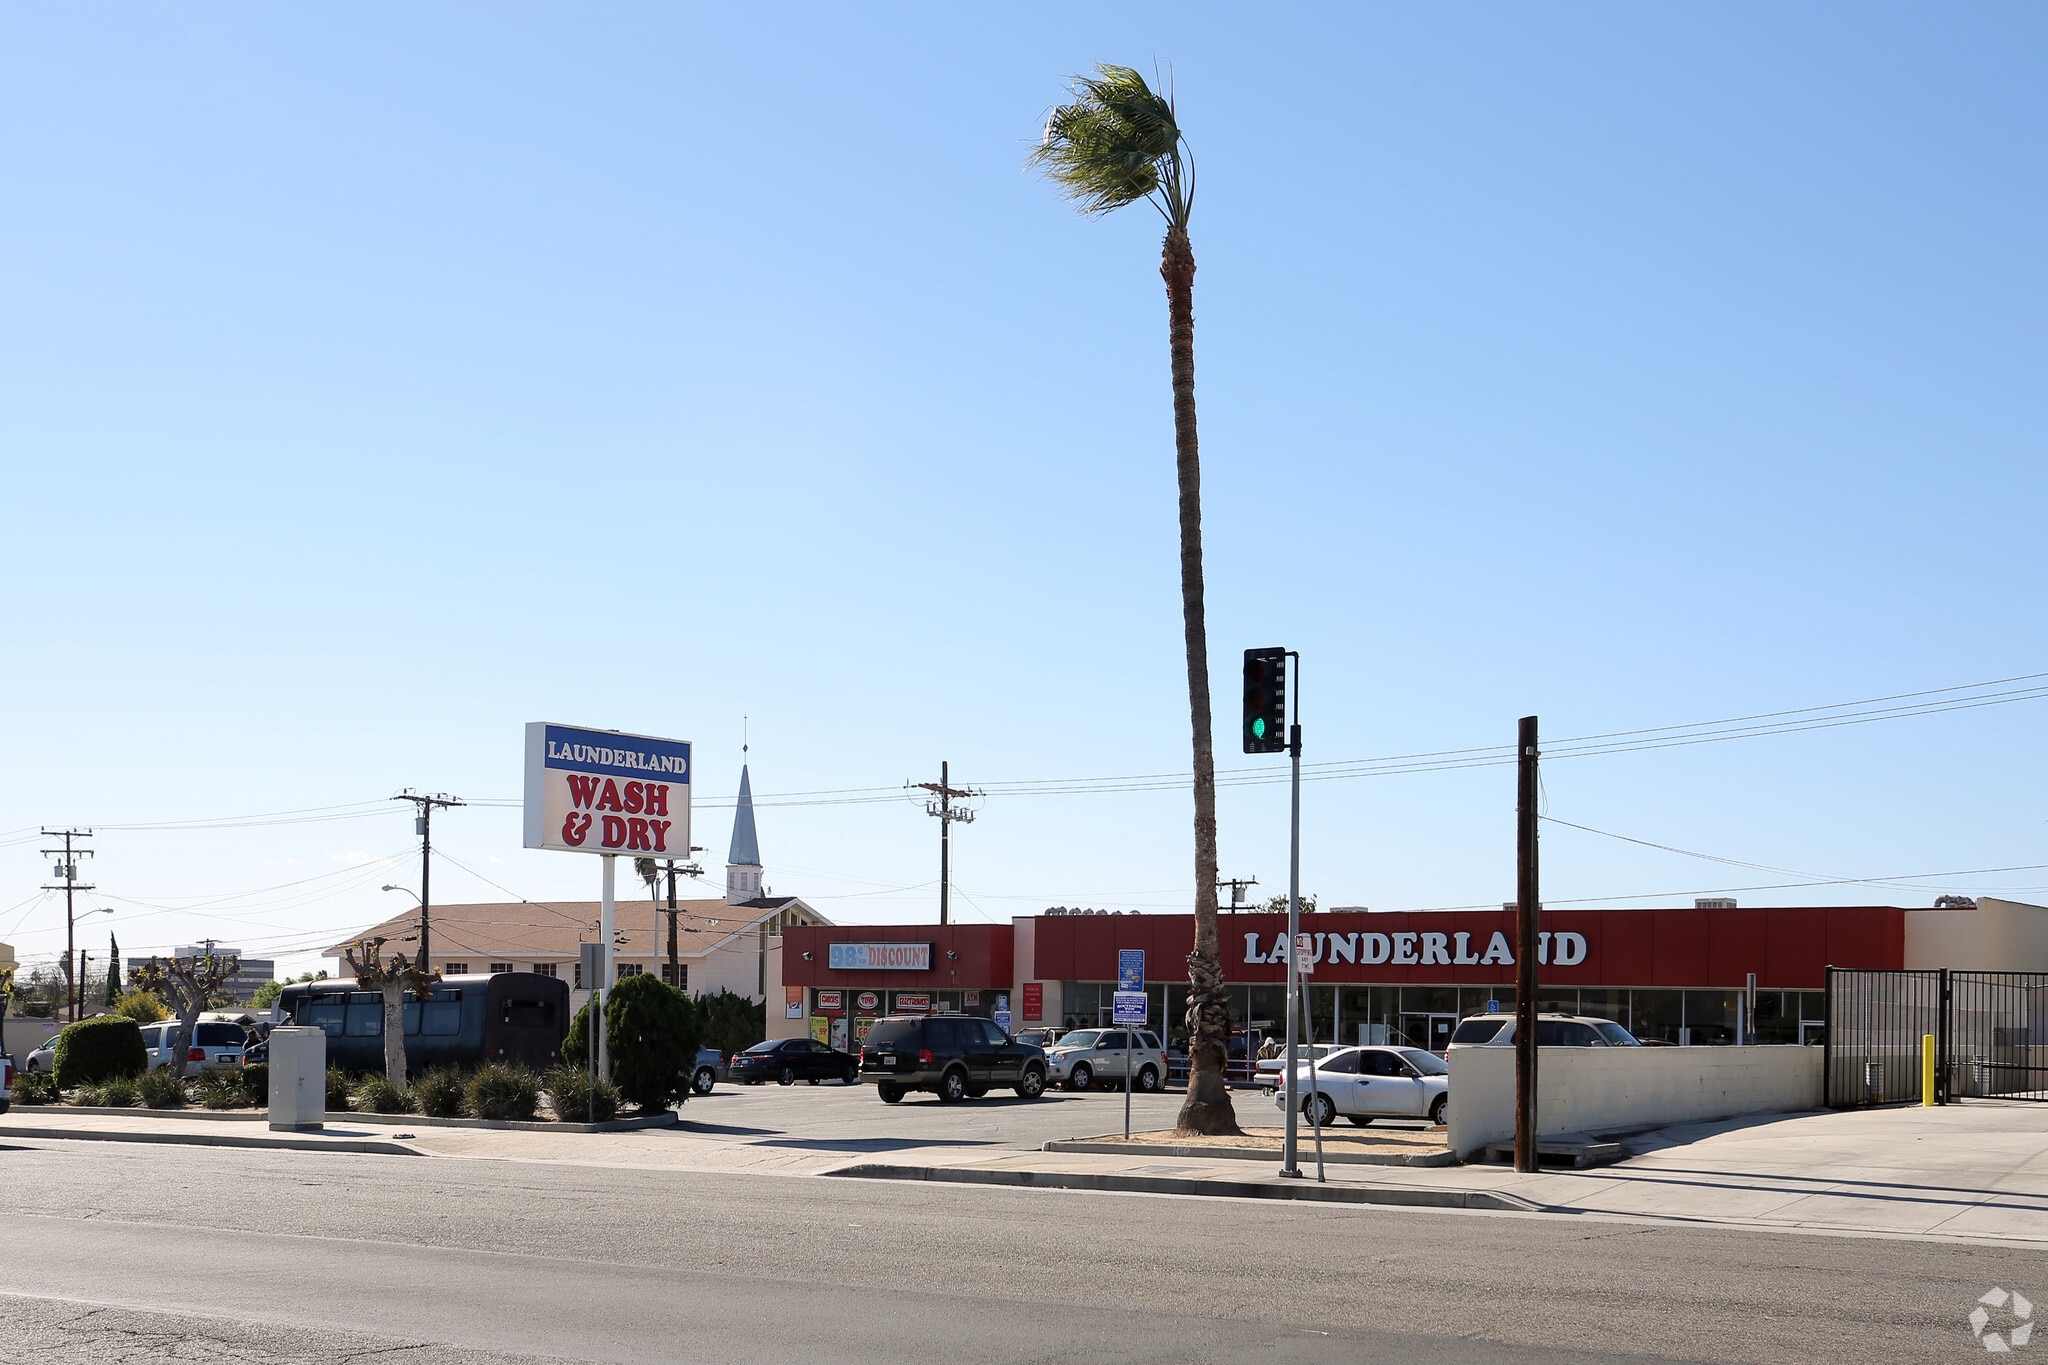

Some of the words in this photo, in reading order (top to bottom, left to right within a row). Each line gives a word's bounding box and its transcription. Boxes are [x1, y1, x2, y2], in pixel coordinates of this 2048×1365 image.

[548, 741, 687, 774] LAUNDERLAND
[566, 774, 670, 817] WASH
[562, 811, 593, 847] &
[600, 815, 672, 852] DRY
[868, 947, 928, 966] DISCOUNT
[966, 992, 979, 1002] ATM
